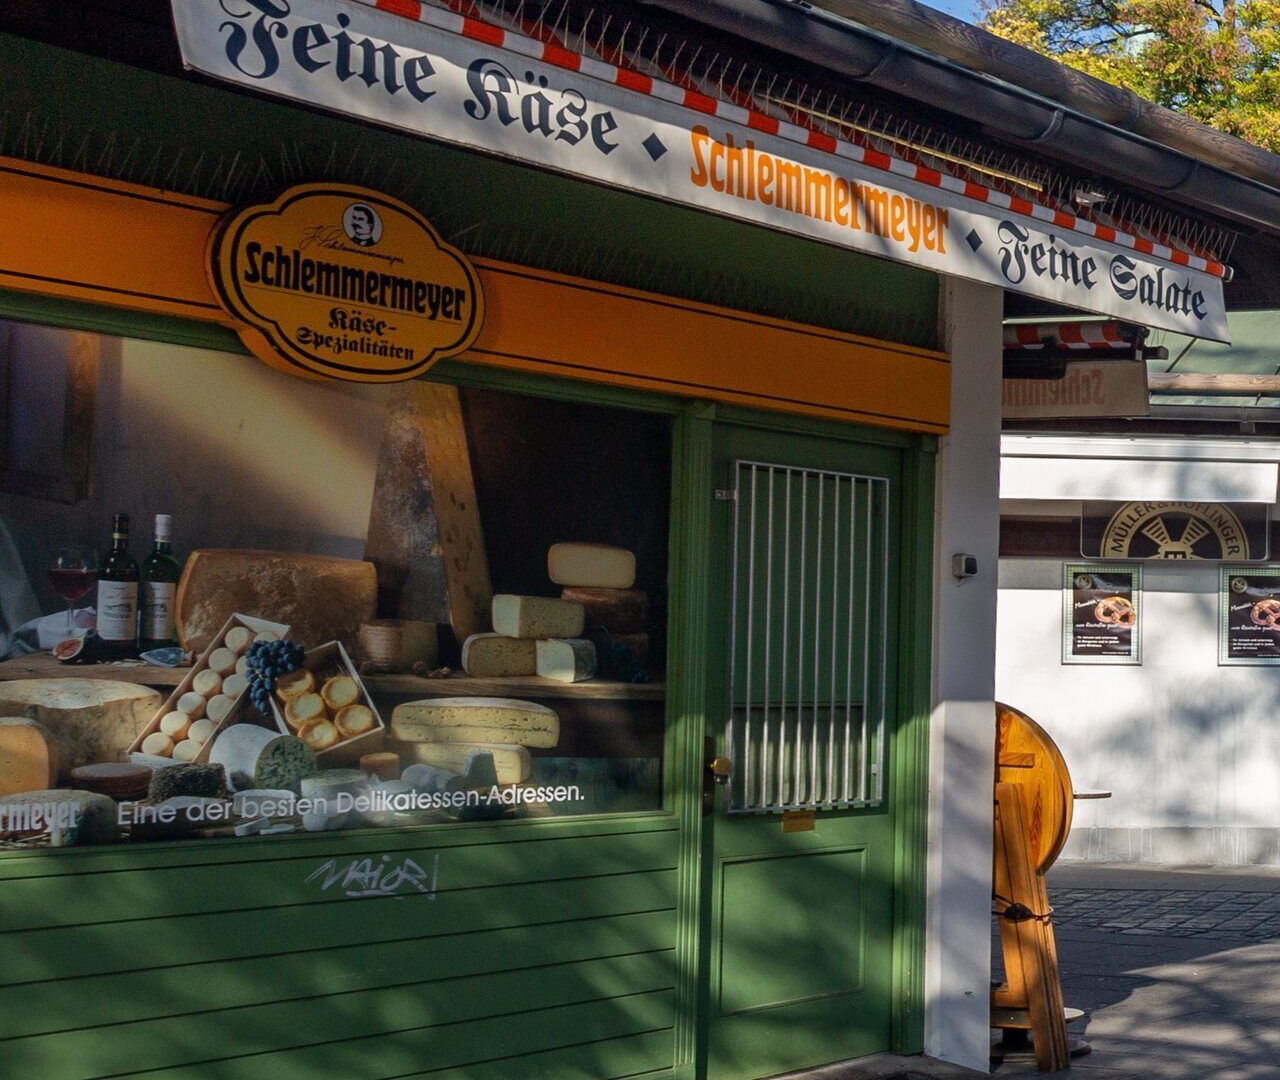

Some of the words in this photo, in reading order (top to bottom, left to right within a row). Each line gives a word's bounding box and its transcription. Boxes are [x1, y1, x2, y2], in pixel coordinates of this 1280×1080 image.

[463, 58, 619, 154] Käse
[691, 125, 949, 254] Schlemmermeyer
[998, 220, 1097, 289] Feine
[1108, 254, 1208, 321] Salate
[244, 241, 466, 321] Schlemmermeyer
[296, 326, 415, 361] Spezialitäten
[329, 307, 397, 337] Käse-
[1111, 502, 1156, 553] MÜLLER
[118, 801, 177, 825] Eine
[186, 797, 233, 821] der
[241, 793, 328, 819] besten
[337, 783, 585, 814] Delikatessen-Adressen.
